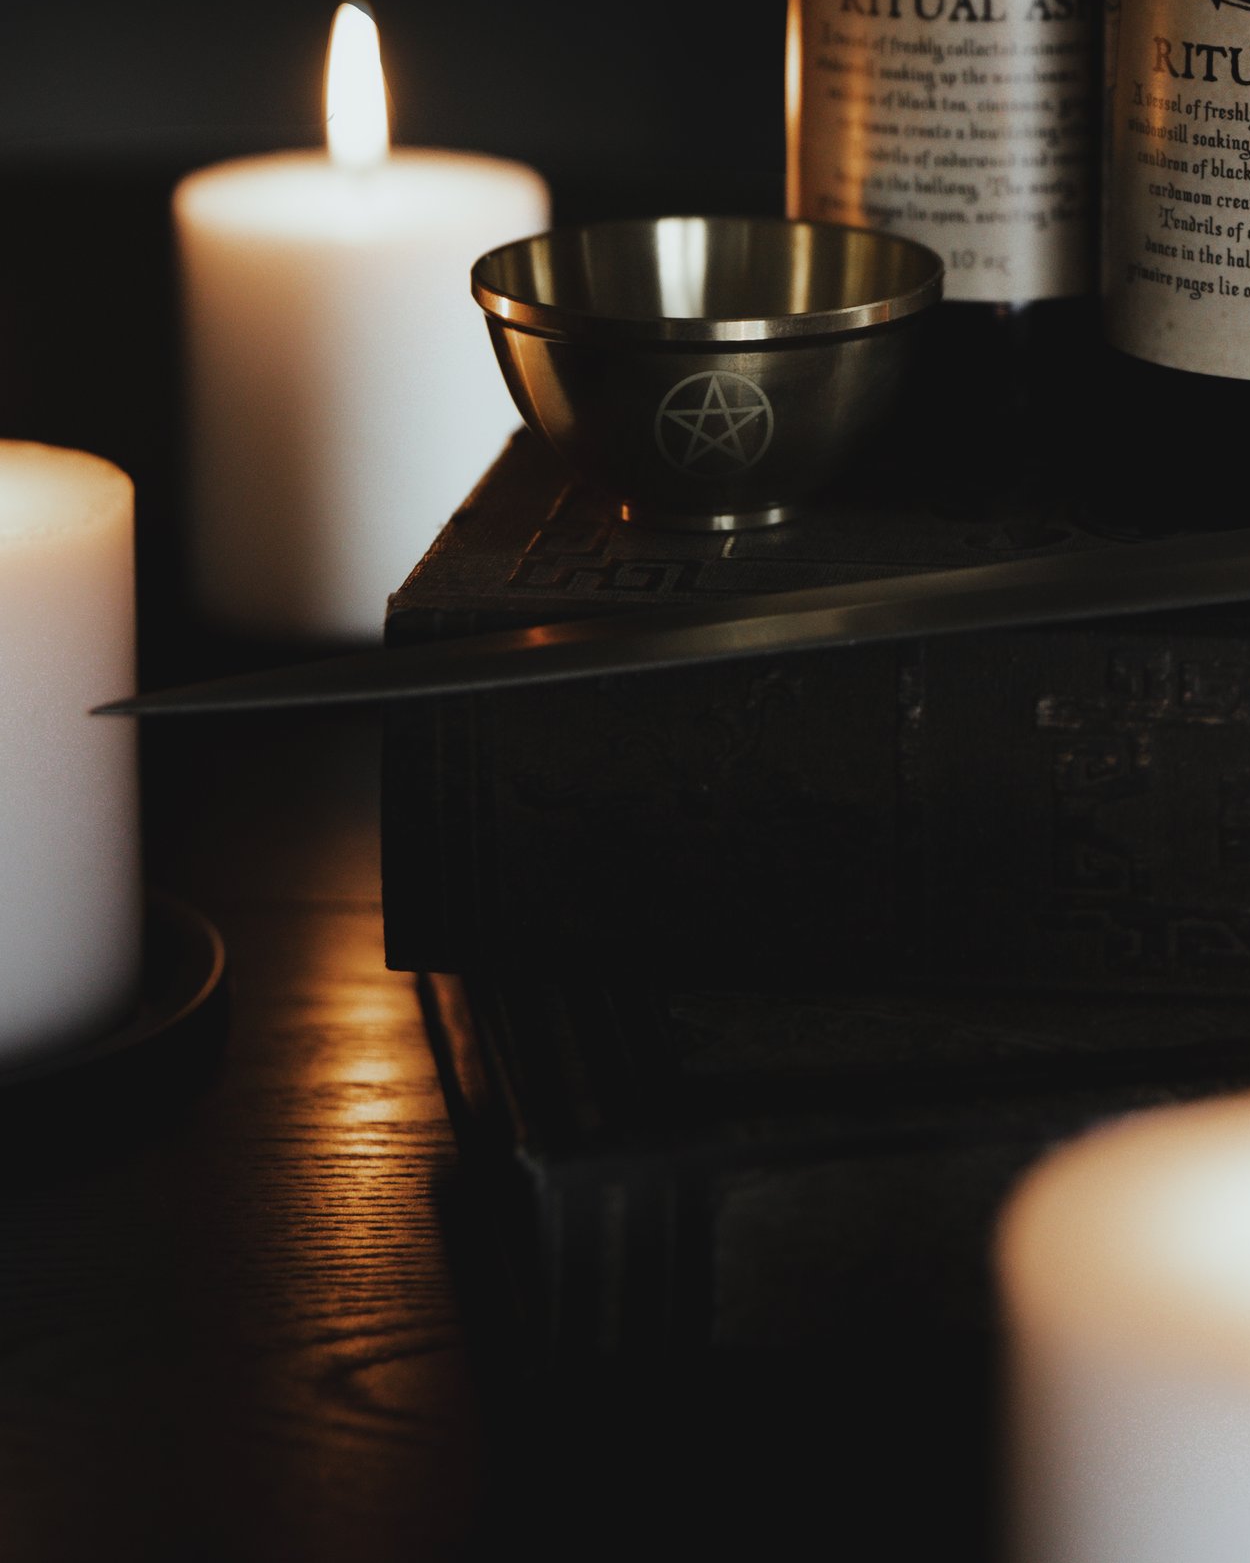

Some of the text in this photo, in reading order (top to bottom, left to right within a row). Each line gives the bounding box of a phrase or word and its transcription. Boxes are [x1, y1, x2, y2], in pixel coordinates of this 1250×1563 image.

[1186, 99, 1201, 120] of
[1192, 159, 1209, 180] of
[1148, 182, 1212, 206] cardamom
[1159, 204, 1223, 237] Tendrils
[1227, 222, 1245, 243] of
[1181, 240, 1195, 262] in
[1199, 244, 1223, 266] the
[1176, 275, 1214, 300] pages
[1219, 275, 1240, 296] lie
